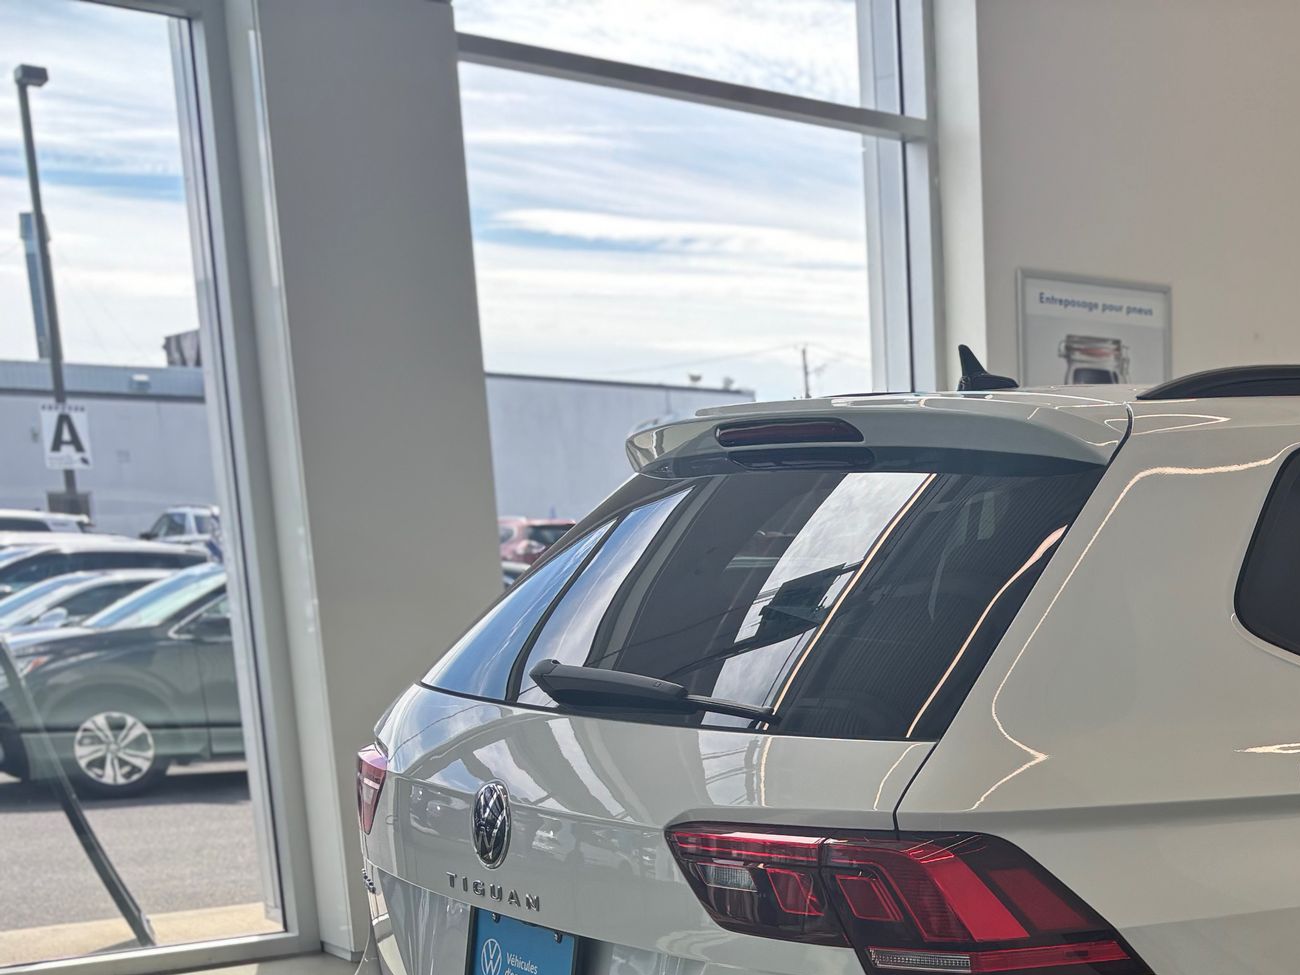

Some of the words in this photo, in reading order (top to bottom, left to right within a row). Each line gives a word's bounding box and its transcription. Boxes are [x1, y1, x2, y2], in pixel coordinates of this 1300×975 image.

[1038, 291, 1099, 312] Entreposage
[1102, 303, 1124, 314] pour
[1126, 305, 1154, 316] pneus
[51, 413, 86, 453] A
[446, 871, 540, 912] TIGUAN
[506, 952, 538, 975] Véhicules
